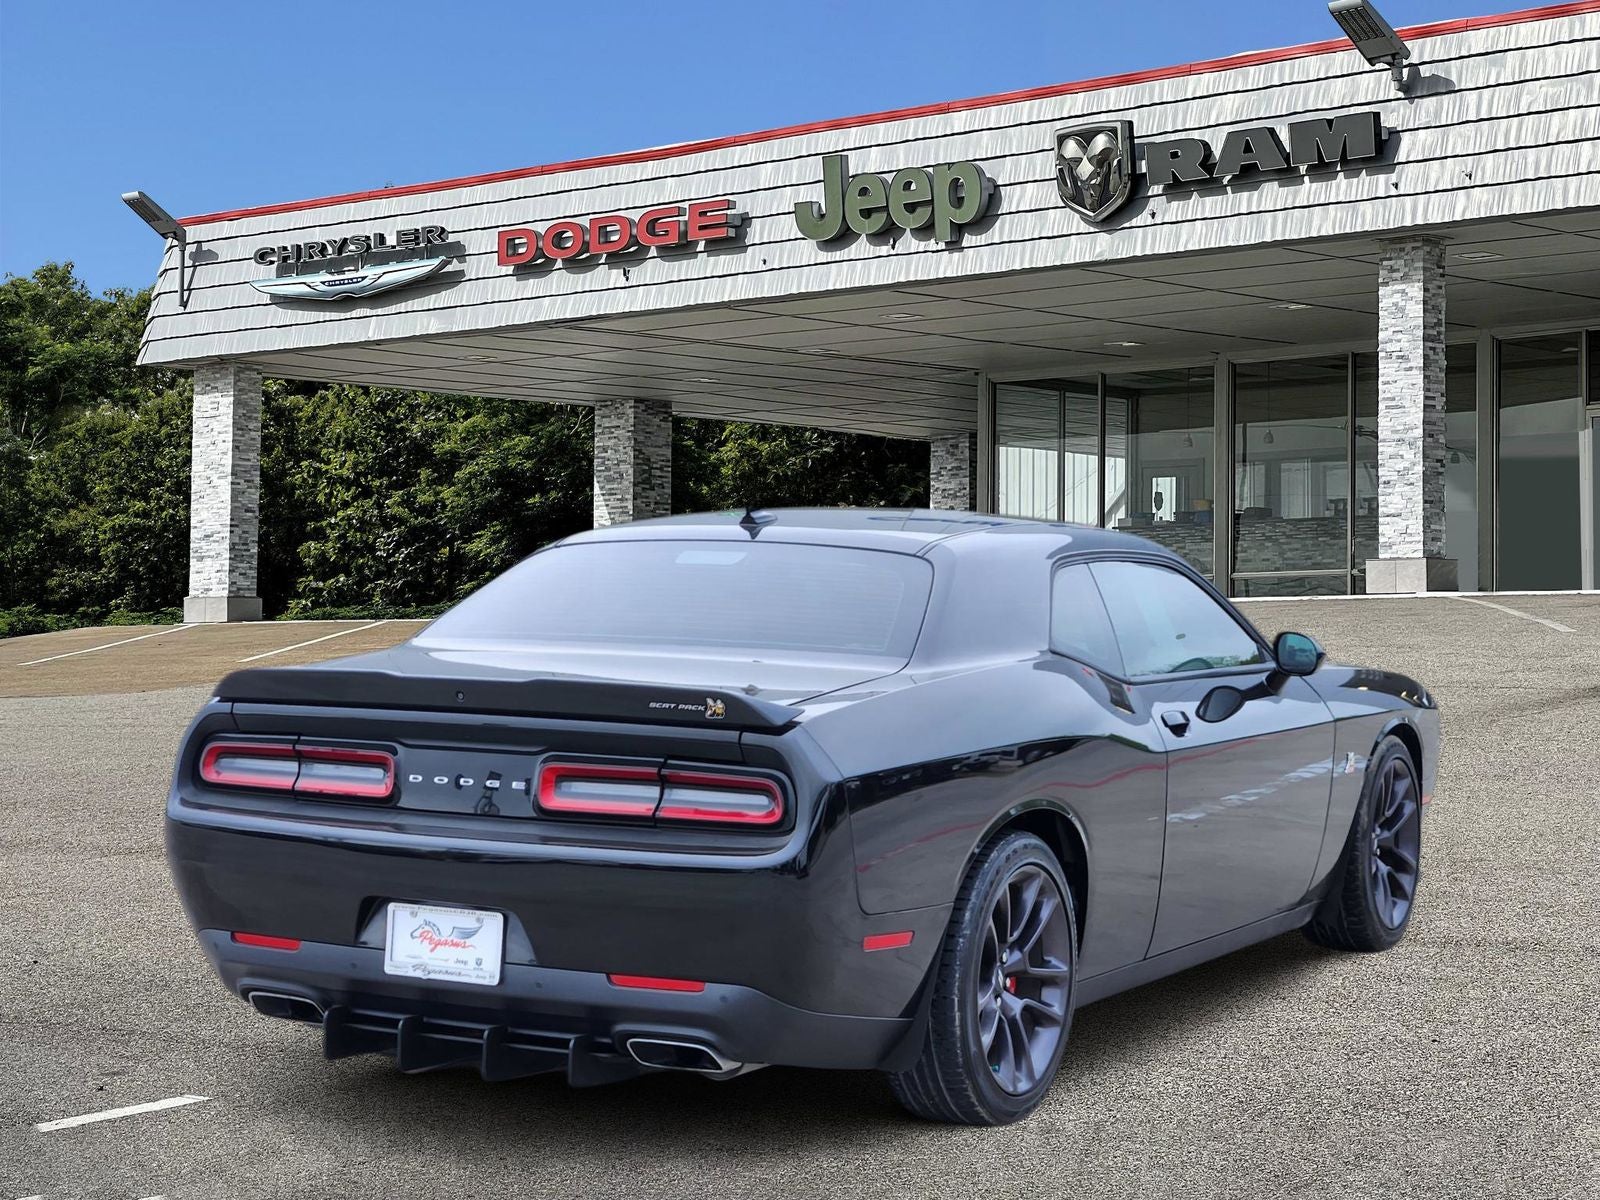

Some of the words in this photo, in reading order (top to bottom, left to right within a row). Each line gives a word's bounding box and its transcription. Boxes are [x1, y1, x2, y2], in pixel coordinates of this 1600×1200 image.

[1147, 111, 1382, 186] RAM
[794, 154, 985, 242] Jeep
[253, 225, 446, 266] CHRYSLER
[498, 199, 734, 267] DODGE
[324, 277, 363, 287] CHRYSLER
[408, 774, 527, 790] DODGE
[418, 930, 477, 953] Pegasus
